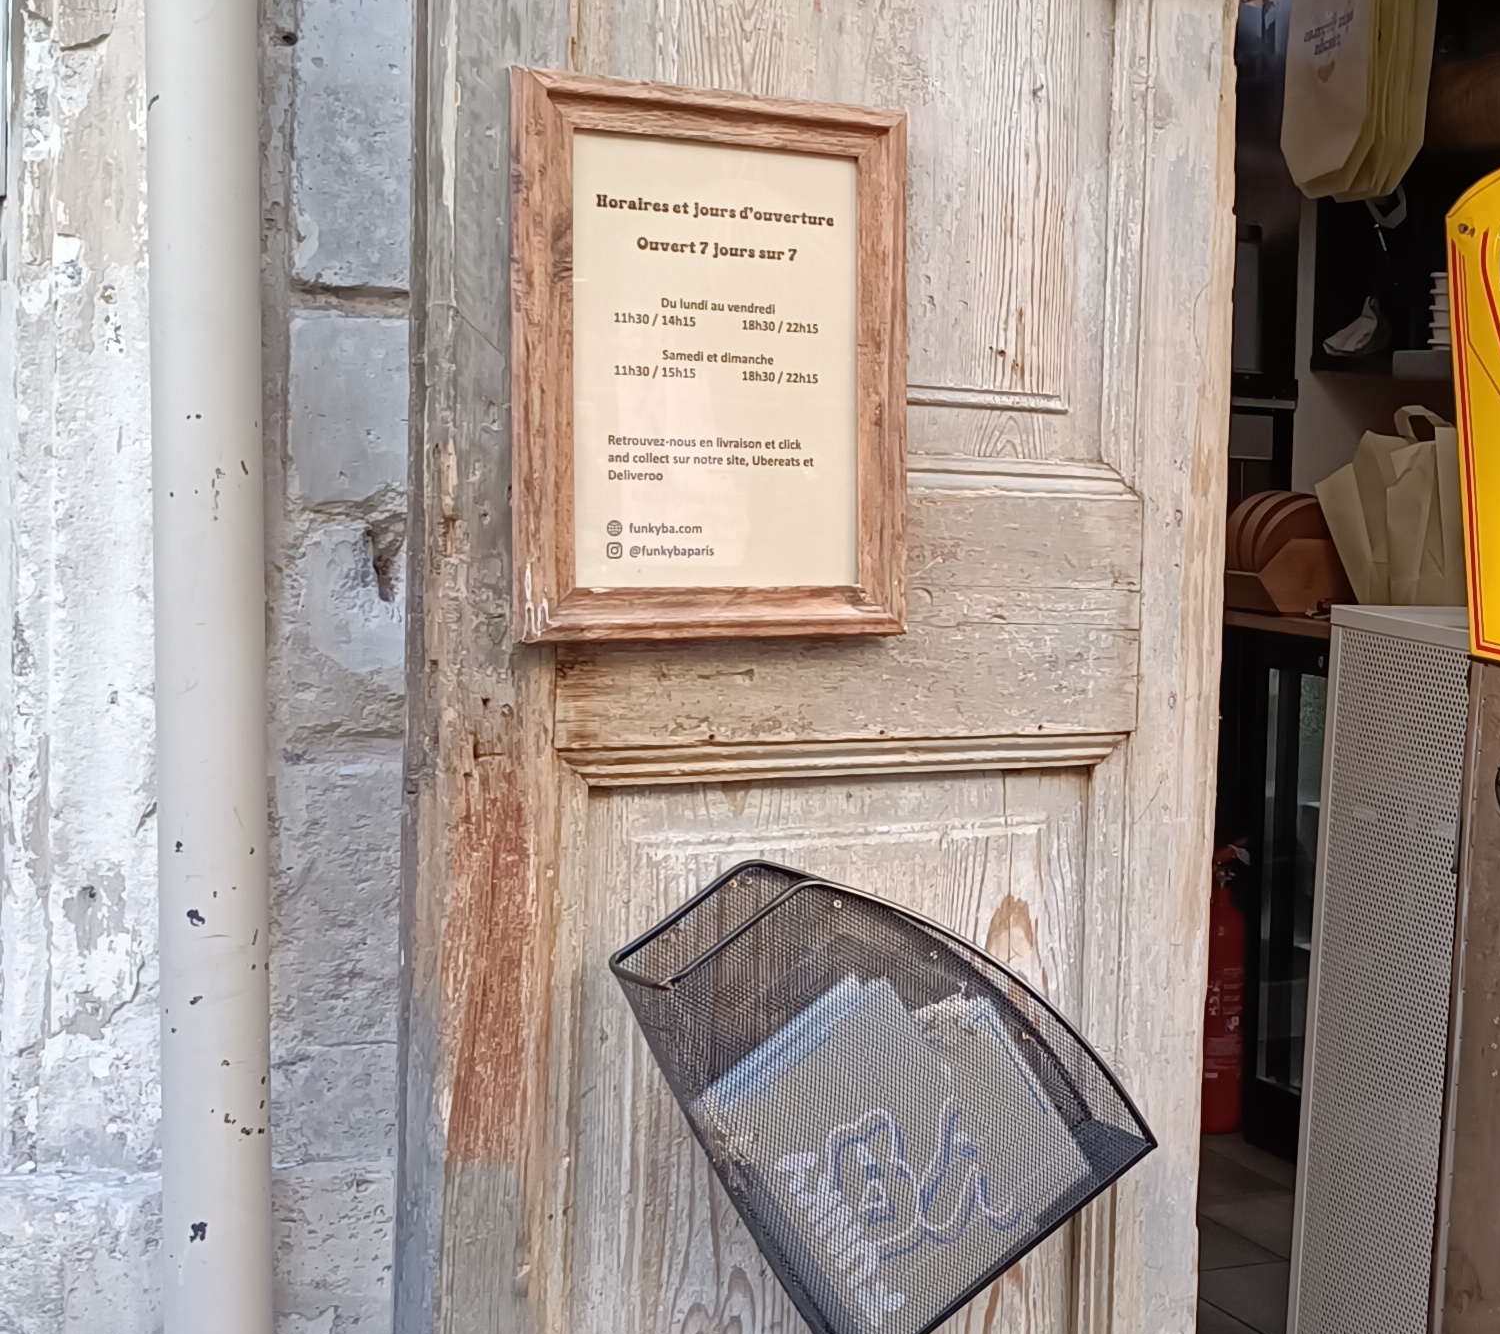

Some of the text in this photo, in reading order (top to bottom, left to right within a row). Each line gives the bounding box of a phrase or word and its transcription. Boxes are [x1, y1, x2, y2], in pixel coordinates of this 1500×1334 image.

[596, 194, 669, 213] Horaires
[672, 203, 689, 215] et
[693, 202, 736, 218] jours
[637, 236, 798, 262] Ouvert 7 jours sur 7
[661, 297, 776, 315] Du lundi au vendredi
[614, 312, 696, 327] 11h30 14h15
[742, 320, 819, 334] 18h30 22h15
[662, 350, 774, 365] Samedi et dimanche
[614, 365, 696, 379] 11h30 15h15
[742, 371, 819, 384] 18h30 22h15
[608, 434, 802, 450] Retrouvez-nous en livraison et click
[608, 452, 814, 467] and collect sur notre site, Ubereats et
[608, 469, 664, 481] Deliveroo
[629, 522, 703, 535] funkyba.com
[629, 545, 715, 558] @funkybaparis
